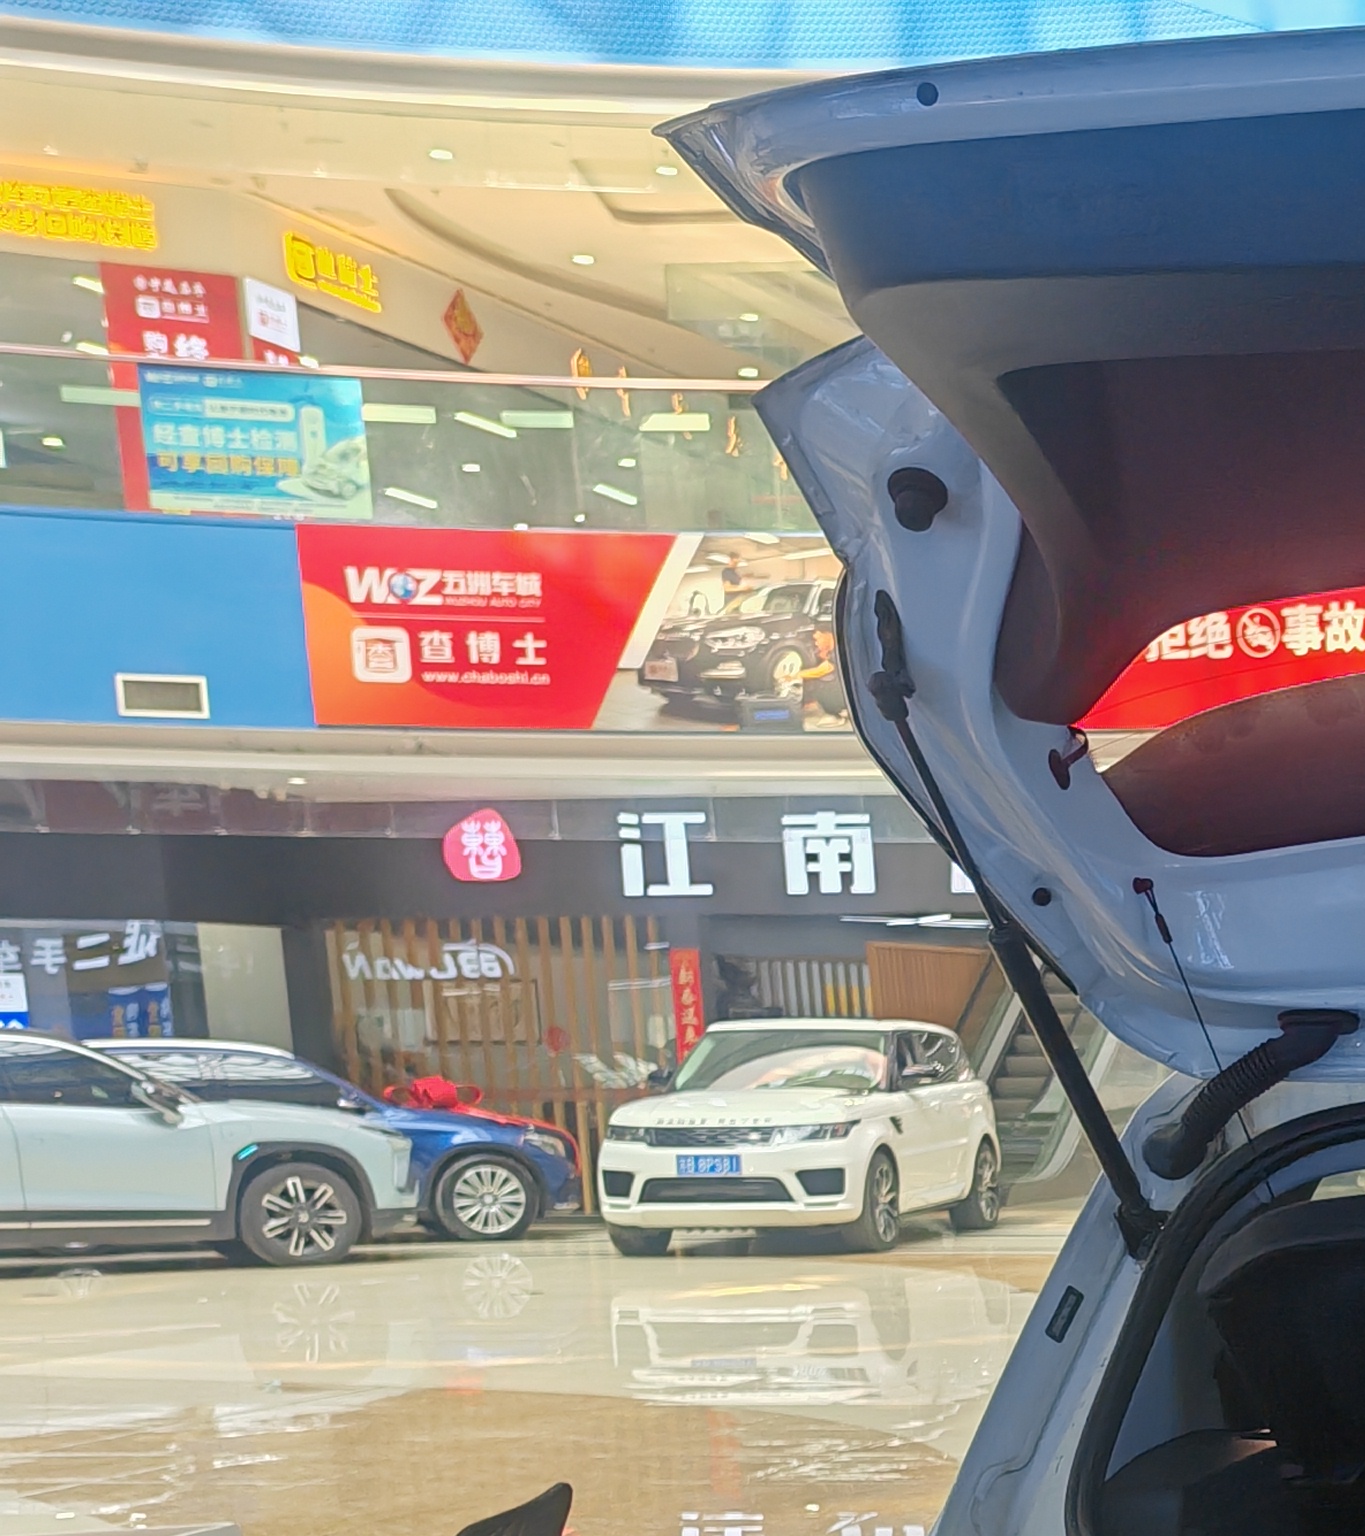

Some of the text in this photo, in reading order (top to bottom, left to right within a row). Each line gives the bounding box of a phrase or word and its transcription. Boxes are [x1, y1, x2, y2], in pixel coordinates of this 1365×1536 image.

[441, 569, 543, 598] 五洲车城
[417, 629, 548, 666] 查博士
[616, 810, 978, 898] 江南
